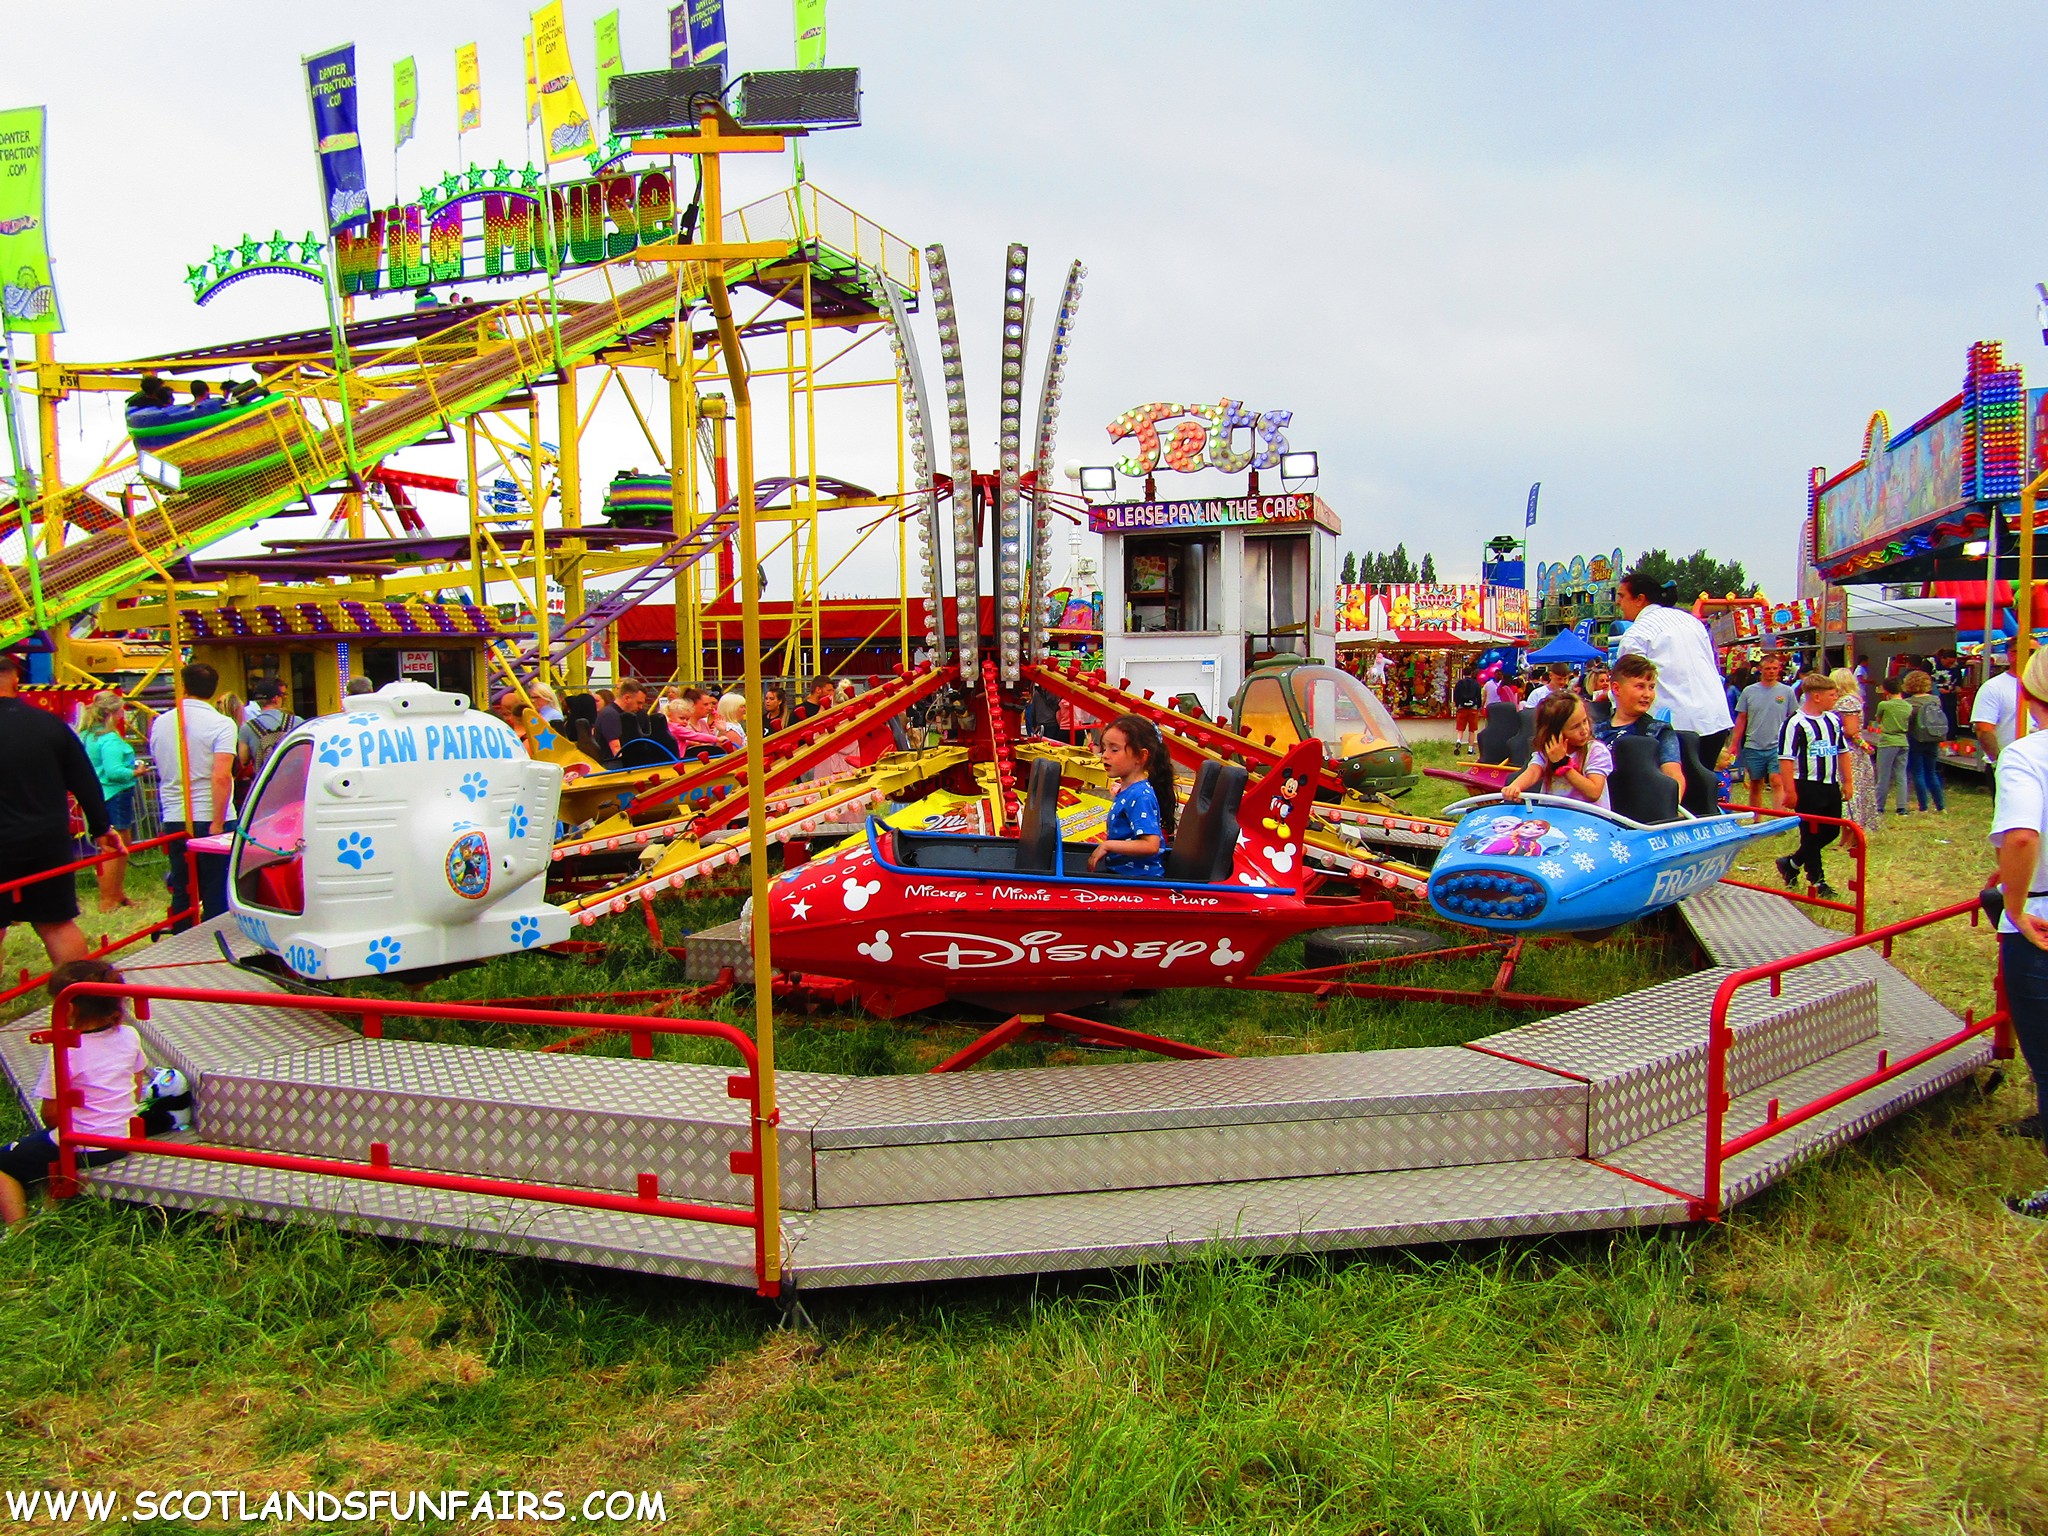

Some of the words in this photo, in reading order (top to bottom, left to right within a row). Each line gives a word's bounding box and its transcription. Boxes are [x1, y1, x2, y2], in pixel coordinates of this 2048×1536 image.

[1106, 397, 1293, 477] Jets
[1107, 503, 1164, 528] PLEASE
[1169, 502, 1202, 523] PAY
[1205, 502, 1222, 522] IN
[1226, 499, 1258, 520] THE
[403, 663, 434, 672] HERE
[407, 653, 429, 661] PAY
[359, 726, 418, 767] PAW
[425, 725, 512, 761] PATROL
[1648, 836, 1669, 851] ELSA
[1692, 826, 1712, 840] OLAF
[1644, 848, 1737, 906] FROZEN
